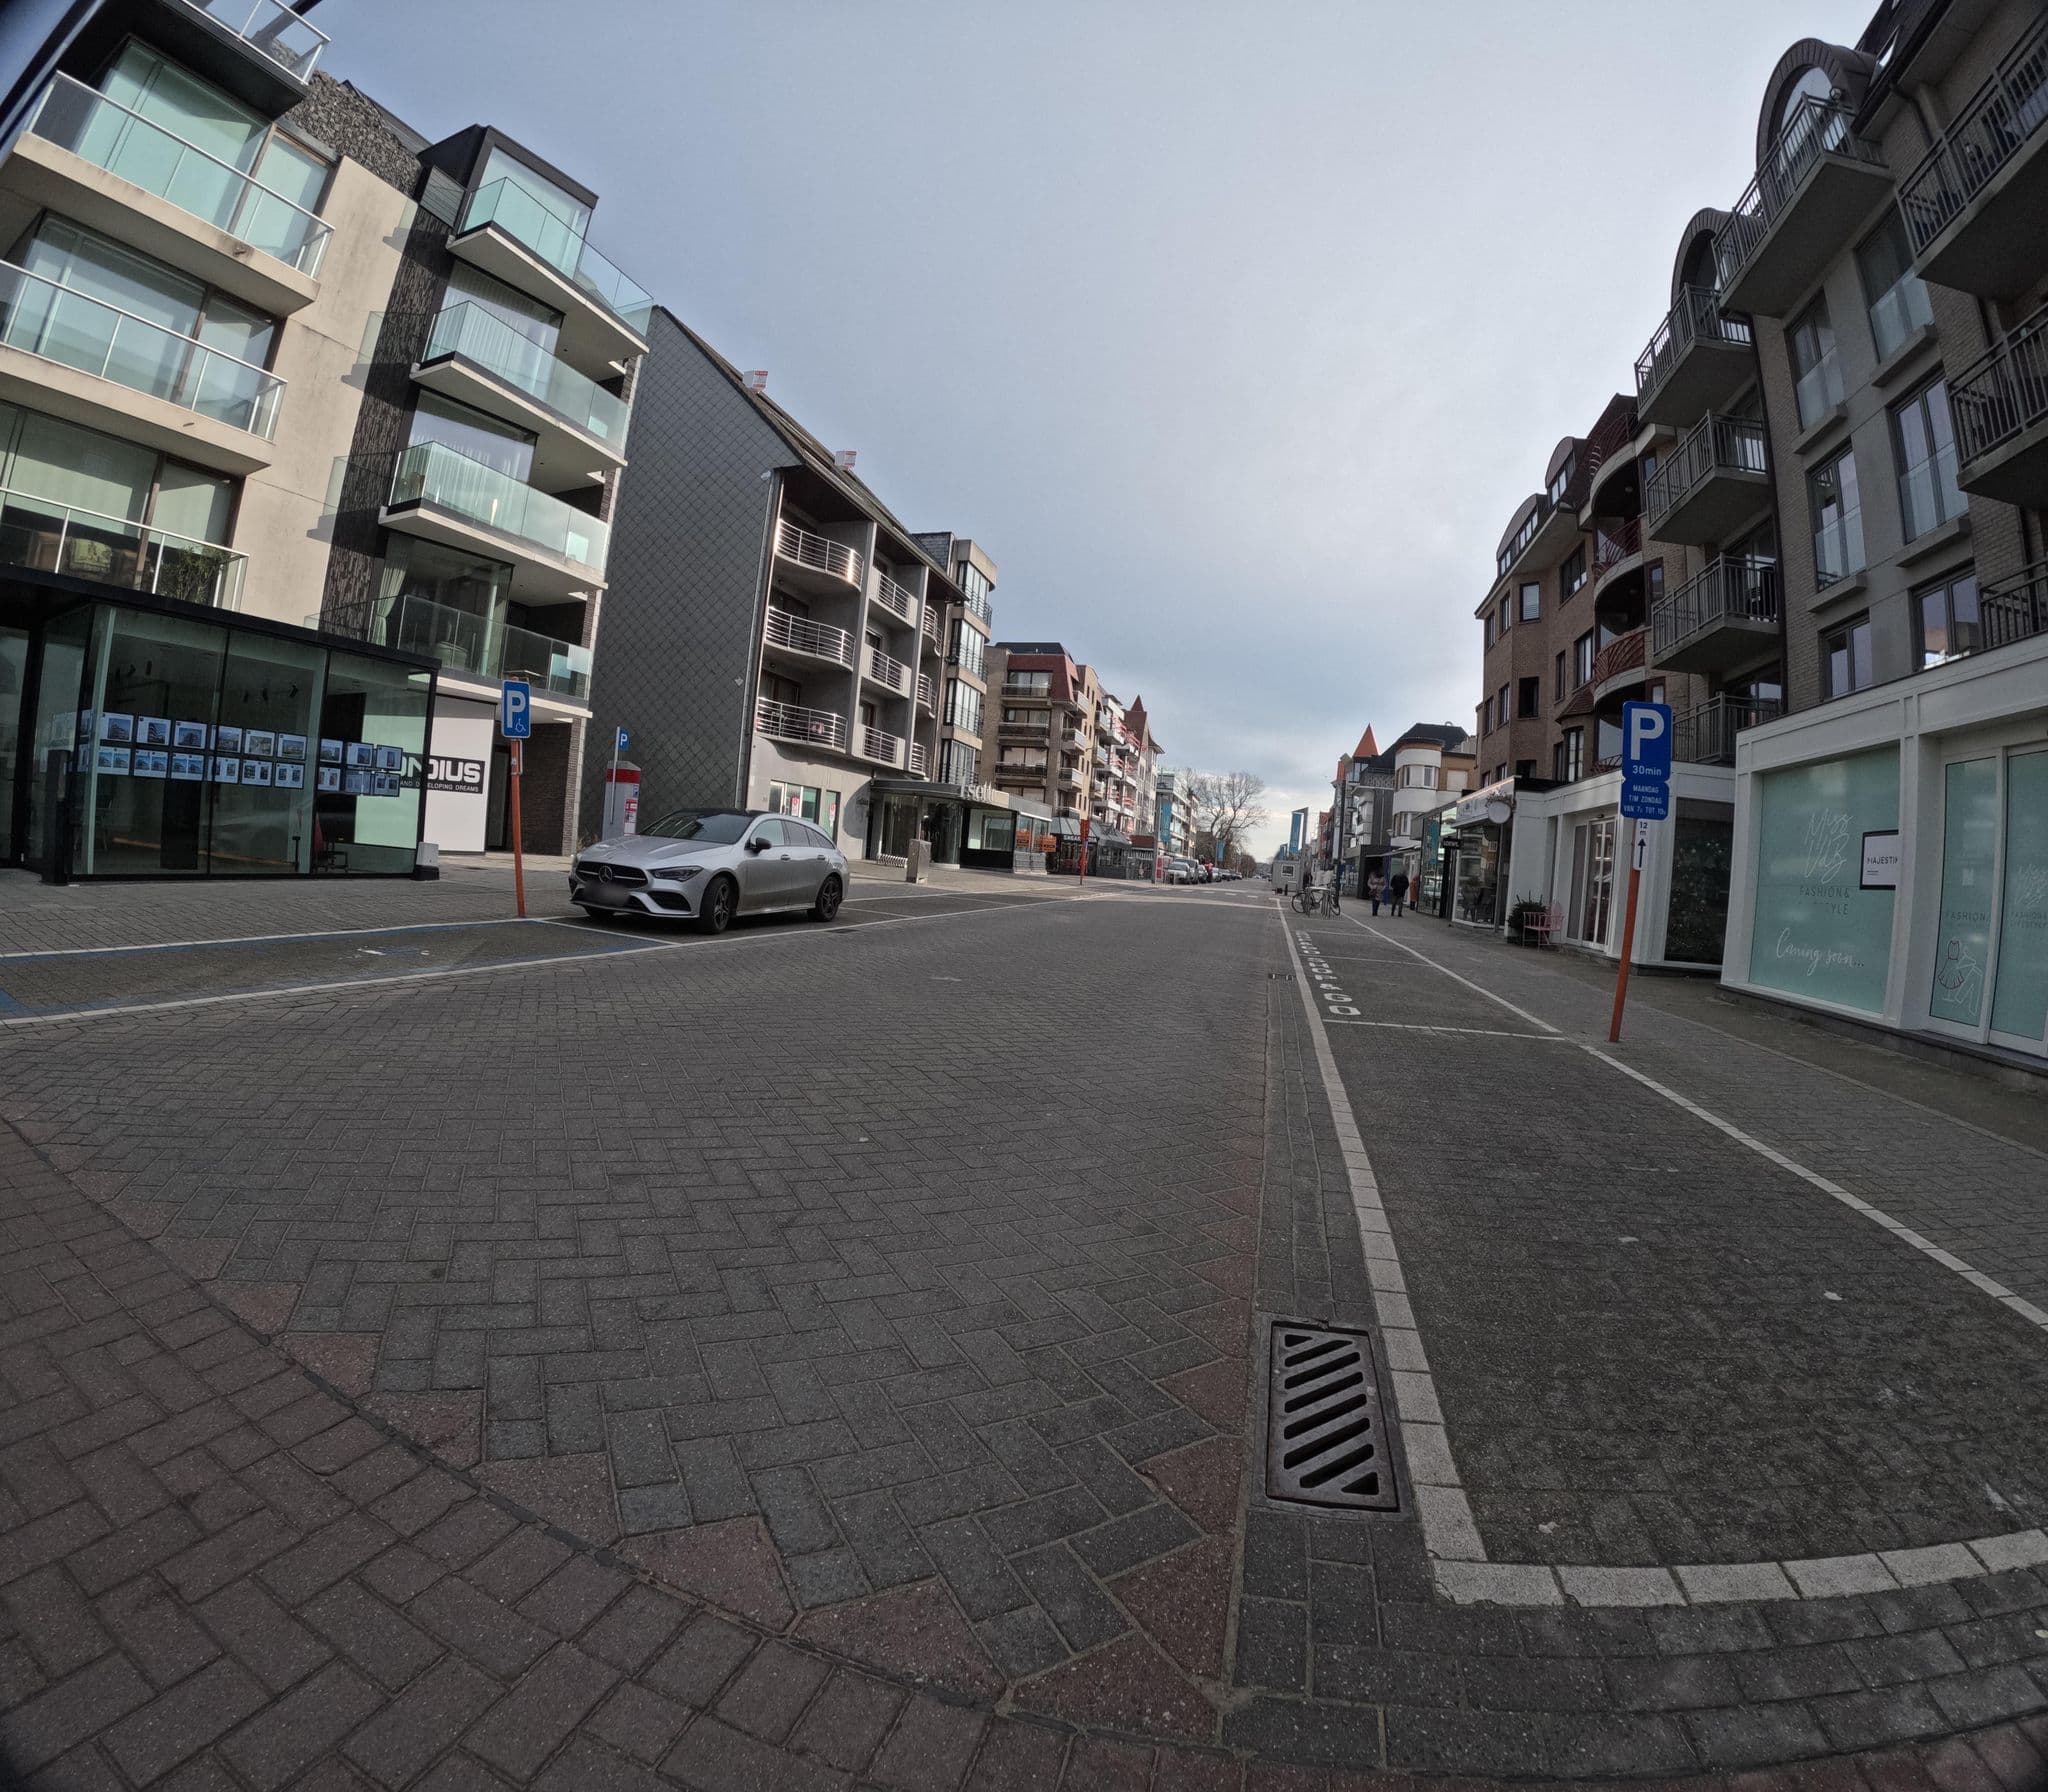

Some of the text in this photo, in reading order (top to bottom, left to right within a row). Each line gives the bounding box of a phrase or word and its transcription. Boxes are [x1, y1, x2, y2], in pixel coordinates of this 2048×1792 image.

[506, 690, 526, 729] P
[620, 733, 628, 746] P
[1630, 708, 1665, 760] P
[1632, 765, 1662, 777] 30min
[416, 781, 453, 790] DELOPING
[455, 785, 479, 793] DREAMS
[1632, 784, 1659, 794] MAANDAG
[1641, 795, 1662, 804] ZONDAG
[1639, 821, 1648, 829] 12
